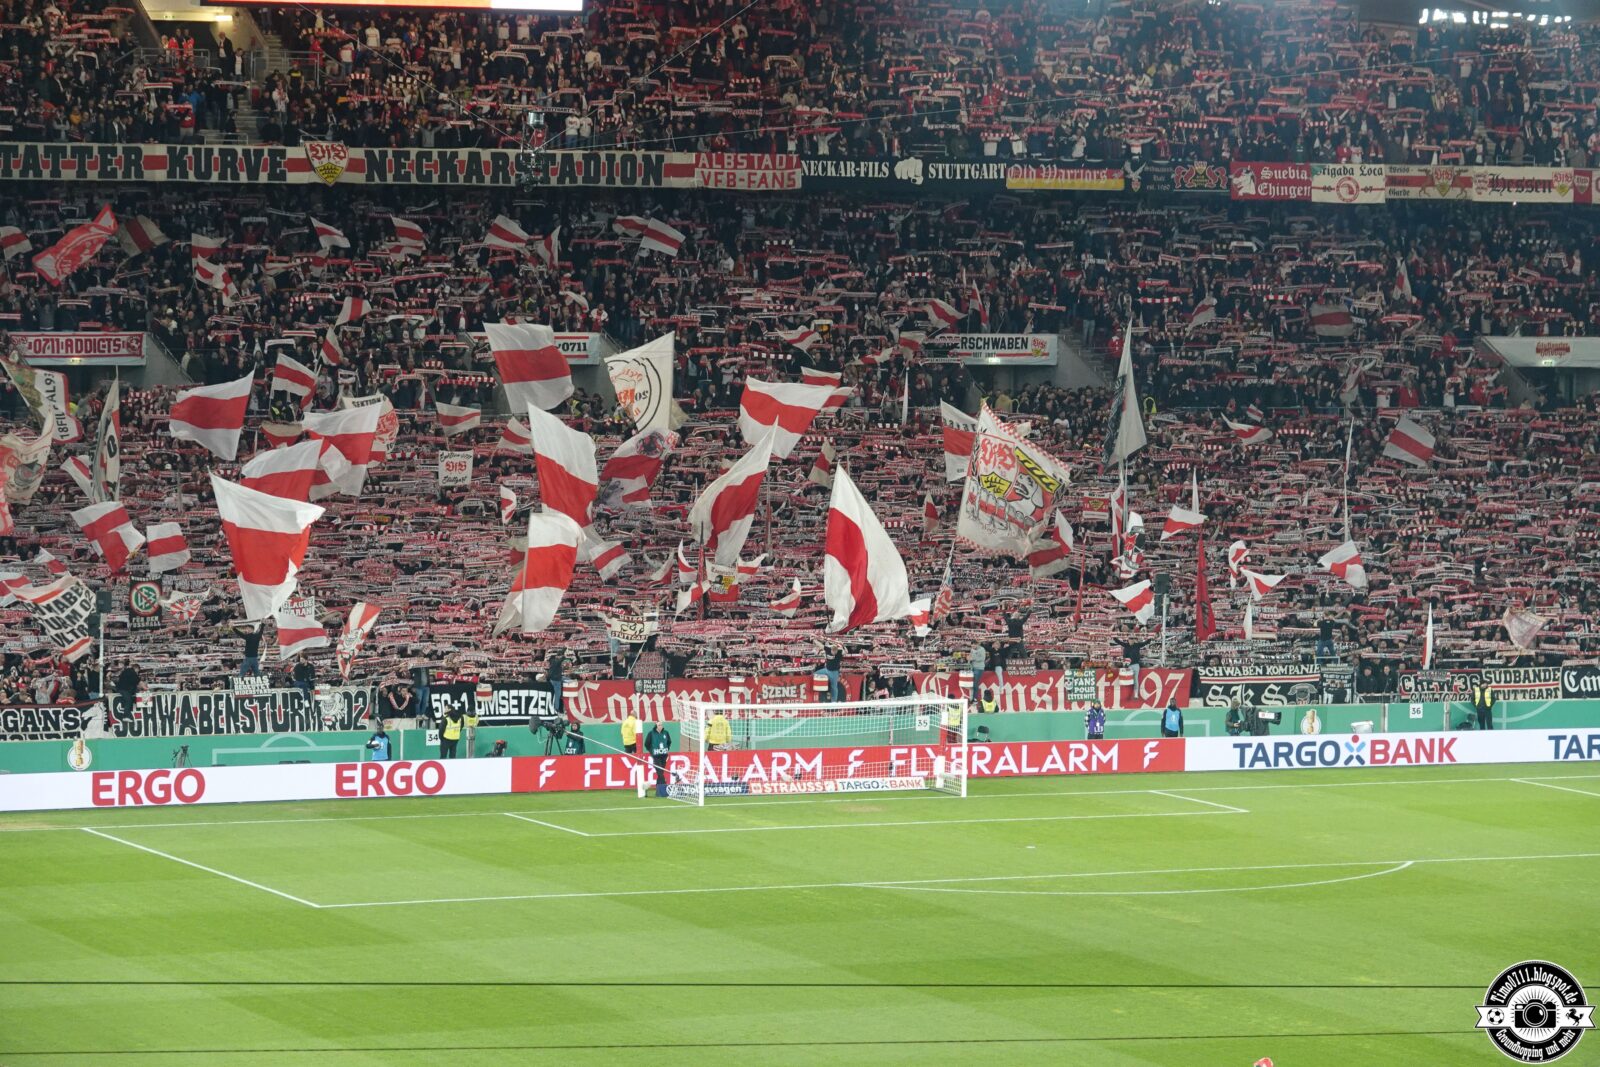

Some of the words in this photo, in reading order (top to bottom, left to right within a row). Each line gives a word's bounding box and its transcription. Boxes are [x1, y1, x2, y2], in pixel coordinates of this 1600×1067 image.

[0, 144, 143, 181] TATTER
[166, 146, 288, 182] KURVE
[698, 153, 798, 169] ALBSTADT
[801, 160, 889, 178] NECKAR-FILS
[928, 163, 1006, 180] STUTTGART
[1007, 164, 1037, 184] Old
[1041, 163, 1109, 185] Warriors
[1316, 165, 1355, 177] rigada
[701, 170, 797, 188] VFB-FANS
[1258, 182, 1312, 198] Ehingen
[65, 337, 122, 354] ADDICTS
[1198, 665, 1263, 676] SCHWABEN
[1266, 664, 1321, 675] KOMPANIE
[233, 675, 269, 685] ULTRAS
[1074, 678, 1096, 686] FANS
[762, 683, 797, 699] SZENE
[1140, 671, 1189, 712] 97
[1494, 687, 1560, 700] TUTTGART
[475, 689, 556, 716] UMSETZEN
[569, 680, 800, 724] Comman
[1411, 707, 1422, 715] 36
[917, 719, 928, 727] 35
[427, 733, 439, 742] 34
[1548, 734, 1600, 760] TAR
[334, 760, 447, 797] ERGO
[764, 780, 823, 793] STRAUSS
[92, 769, 206, 806] ERGO
[683, 784, 742, 795] Volswagen
